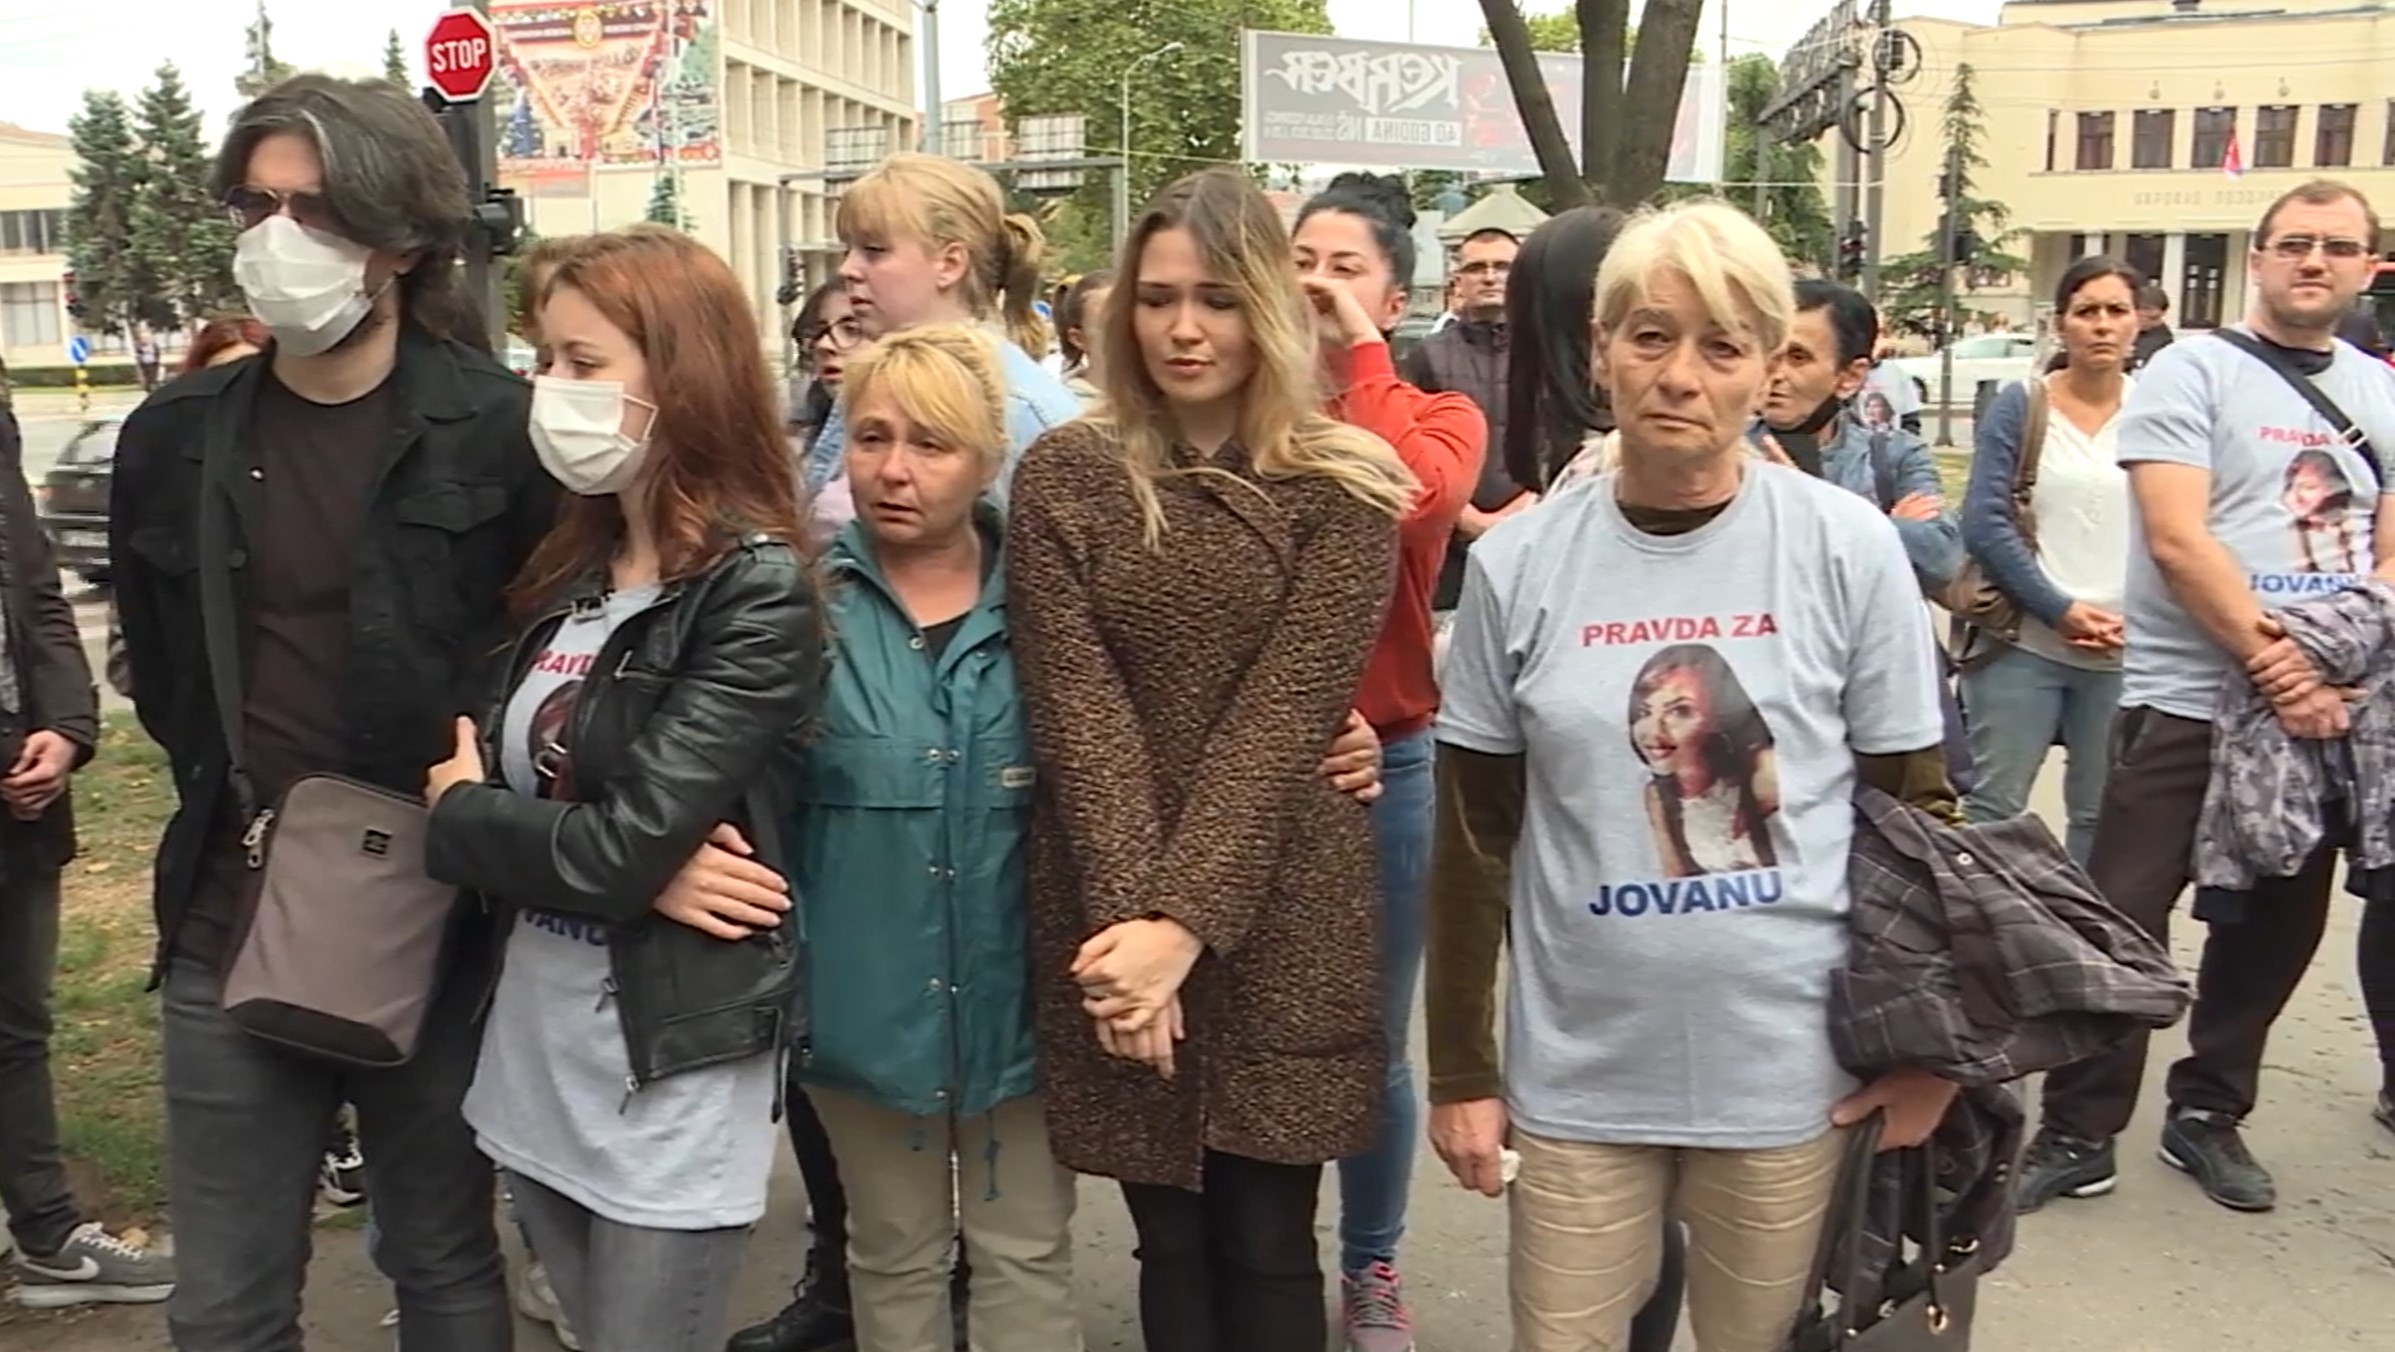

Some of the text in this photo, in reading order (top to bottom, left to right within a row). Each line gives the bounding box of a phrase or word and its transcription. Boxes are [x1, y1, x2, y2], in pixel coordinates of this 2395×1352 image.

[431, 37, 487, 73] STOP
[1582, 613, 1779, 648] PRAVDA ZA
[1589, 871, 1783, 917] JOVANU
